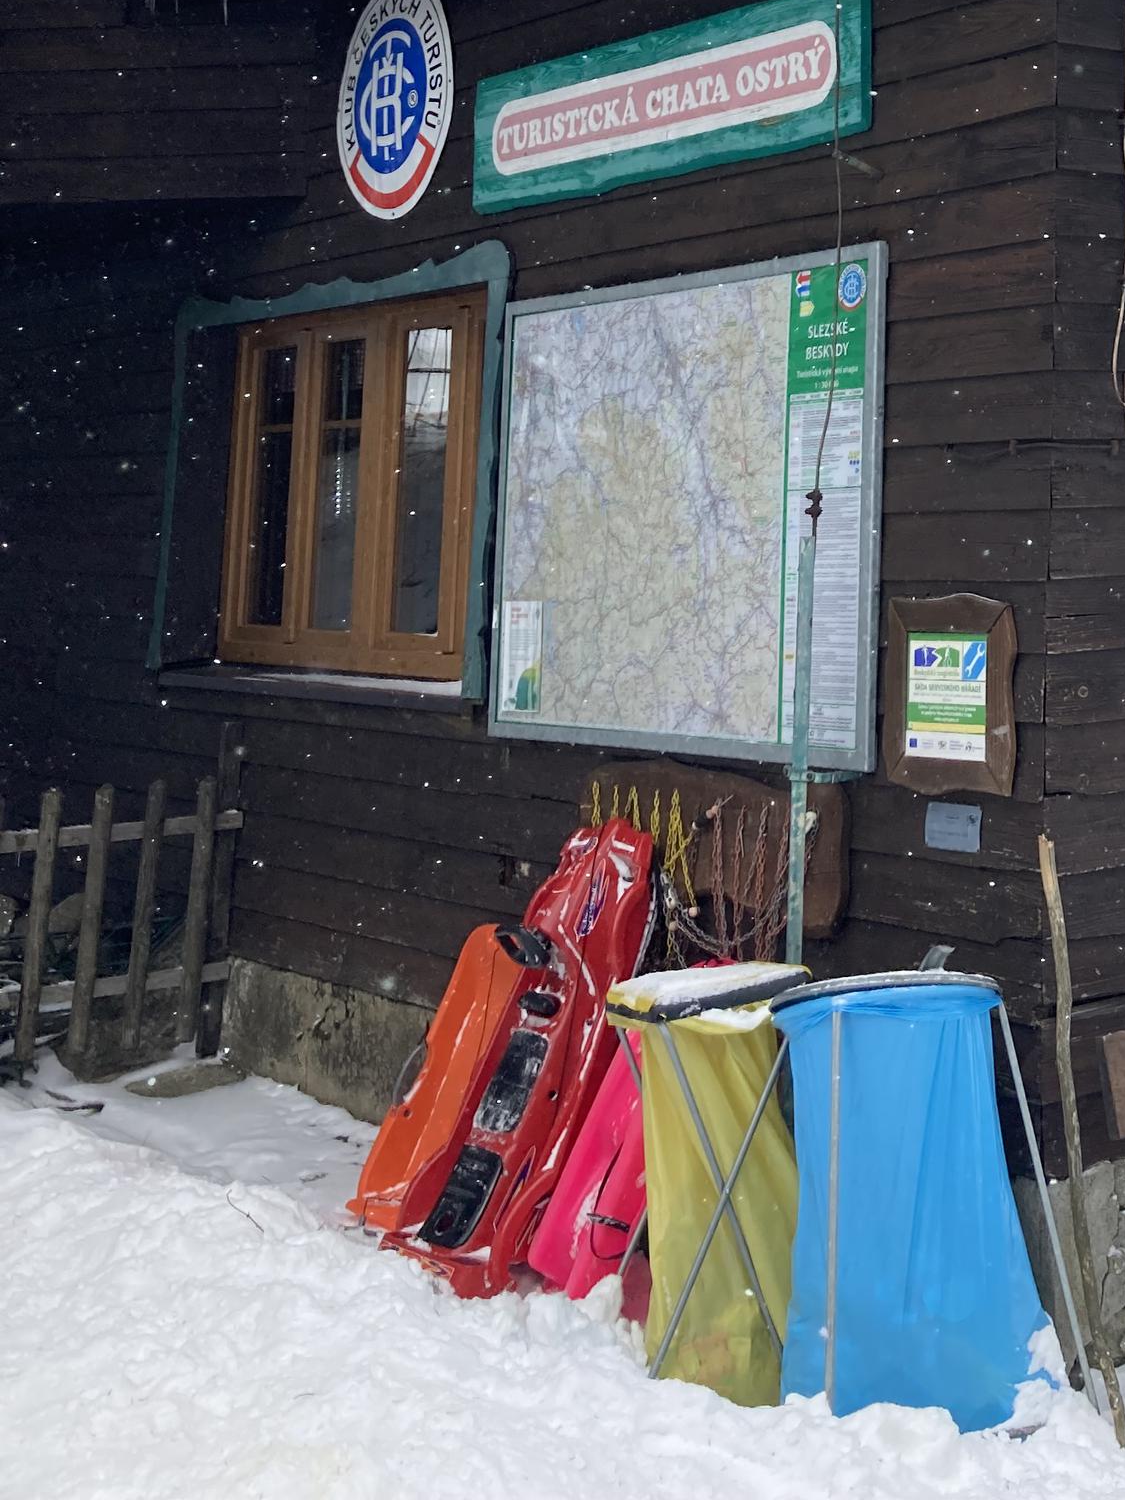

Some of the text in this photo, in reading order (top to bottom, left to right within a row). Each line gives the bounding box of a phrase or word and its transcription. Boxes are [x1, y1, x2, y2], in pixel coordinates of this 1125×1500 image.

[344, 75, 356, 151] KLUB
[418, 10, 444, 130] TURISTŮ
[499, 37, 827, 154] TURISTICKÁ CHATA OSTRÝ
